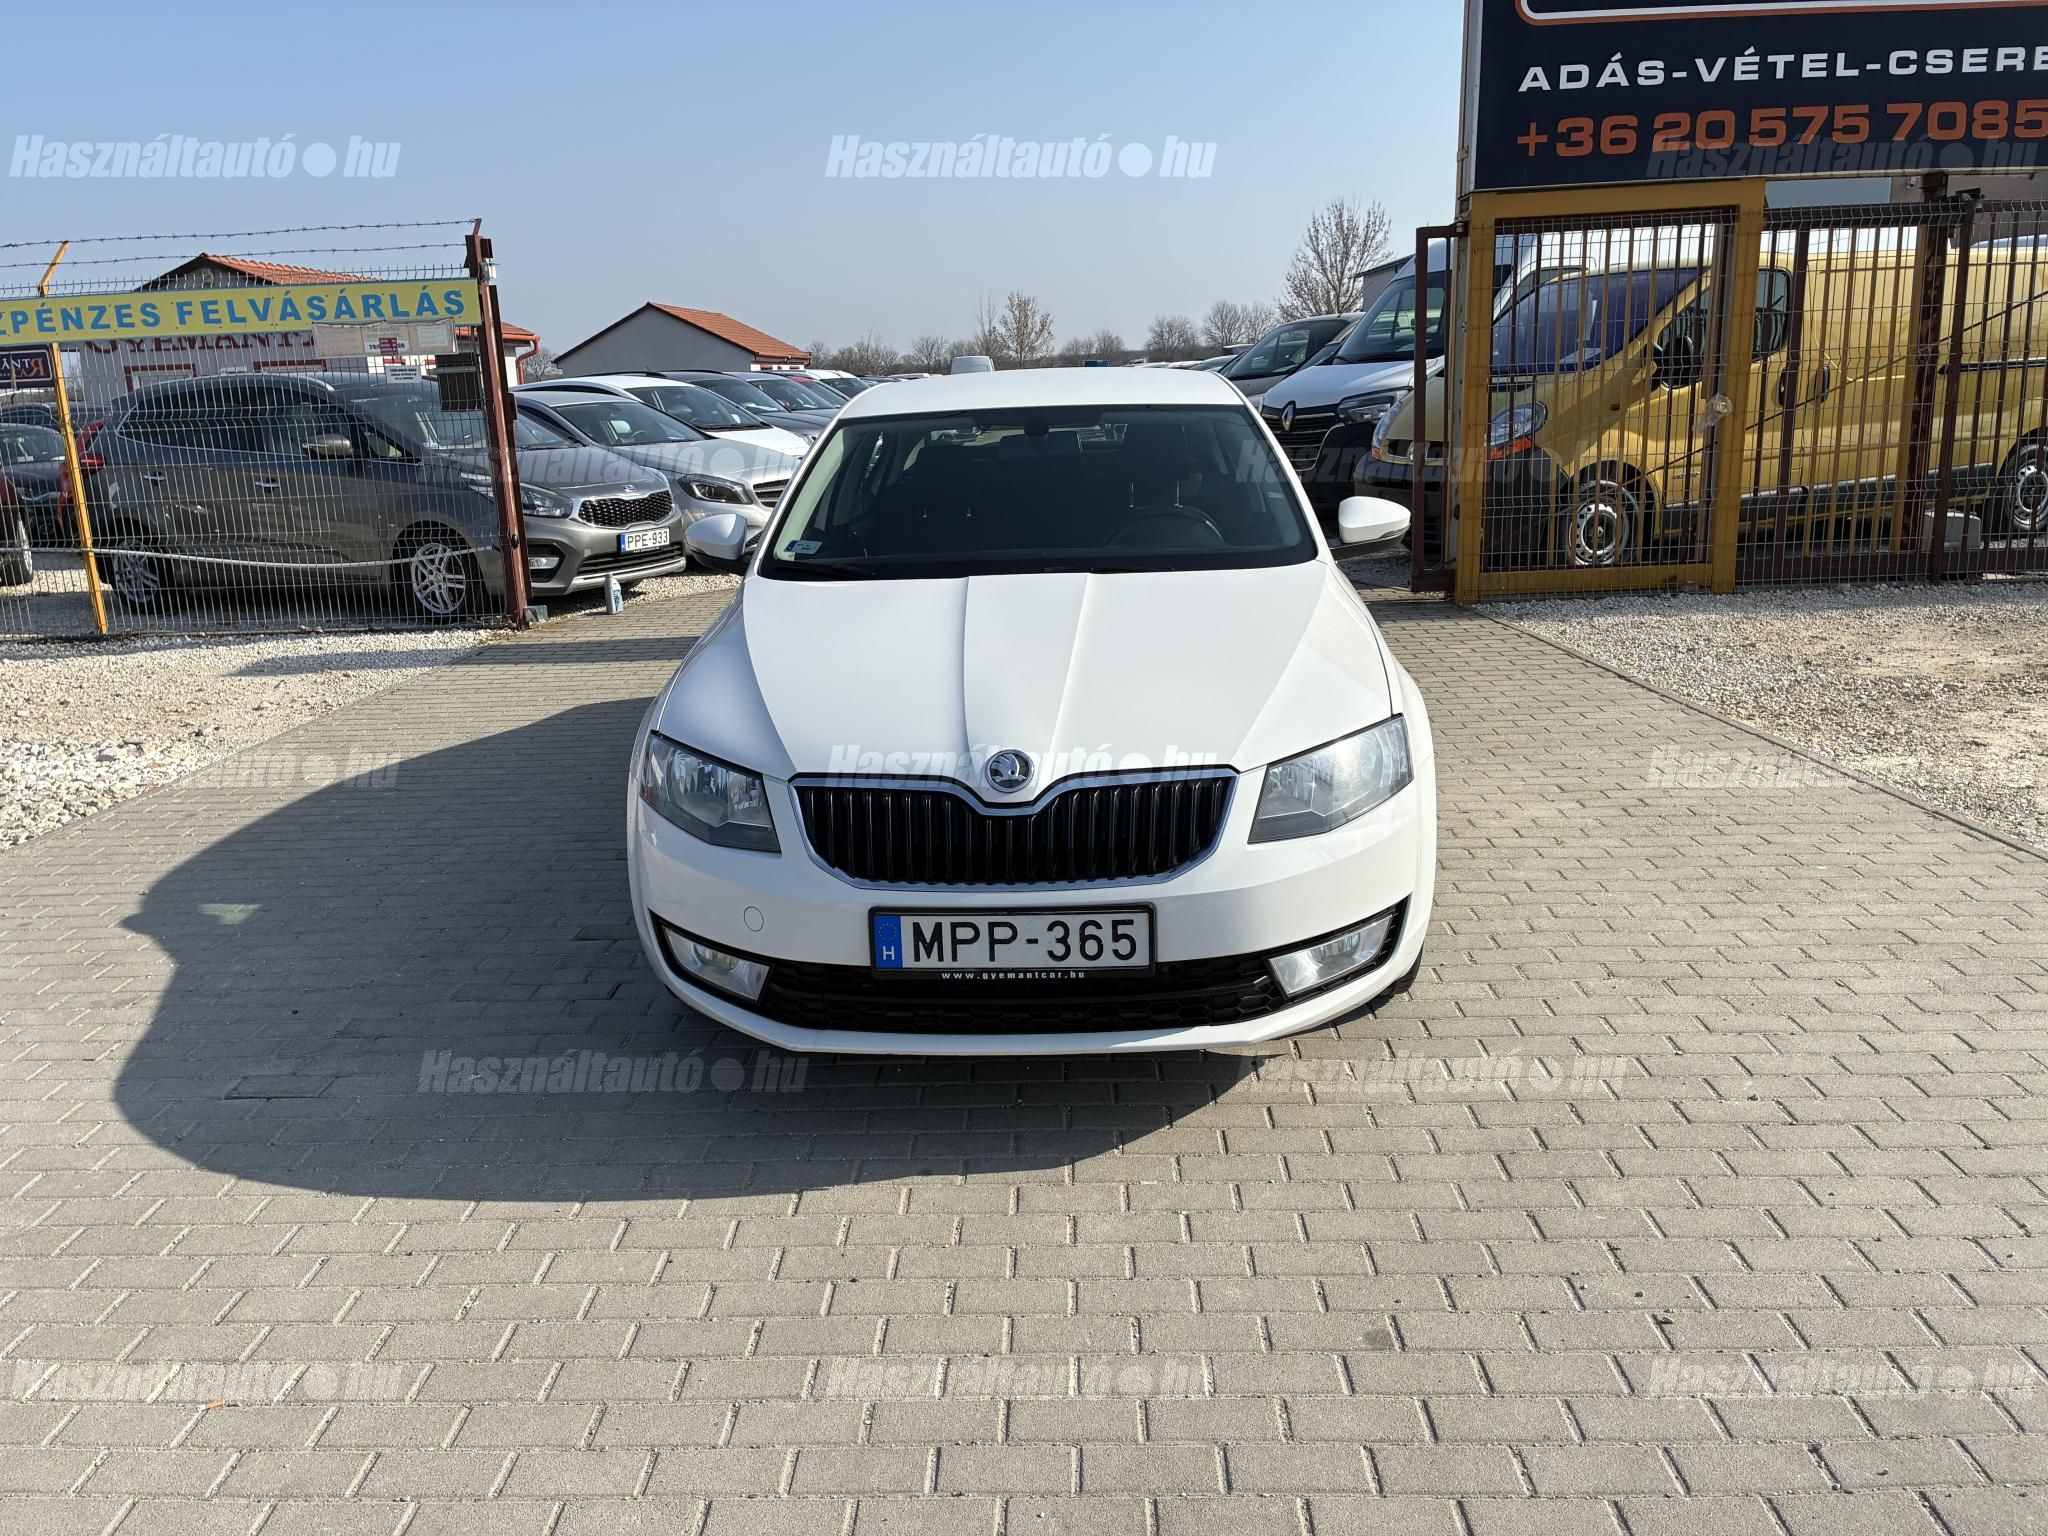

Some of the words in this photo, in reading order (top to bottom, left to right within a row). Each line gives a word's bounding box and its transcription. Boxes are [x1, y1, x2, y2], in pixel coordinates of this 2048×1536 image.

[1517, 45, 2048, 92] ADÁS-VÉTEL-CSERE
[1517, 116, 1639, 157] +36
[1652, 110, 1736, 153] 20
[1749, 104, 1870, 147] 575
[1886, 99, 2048, 141] 7085
[175, 285, 465, 326] FELVÁSÁRLÁS
[626, 531, 668, 550] PPE-933
[882, 945, 895, 961] H
[912, 919, 1137, 963] MPP-365
[941, 971, 1085, 980] www.gyemantcar.hu
